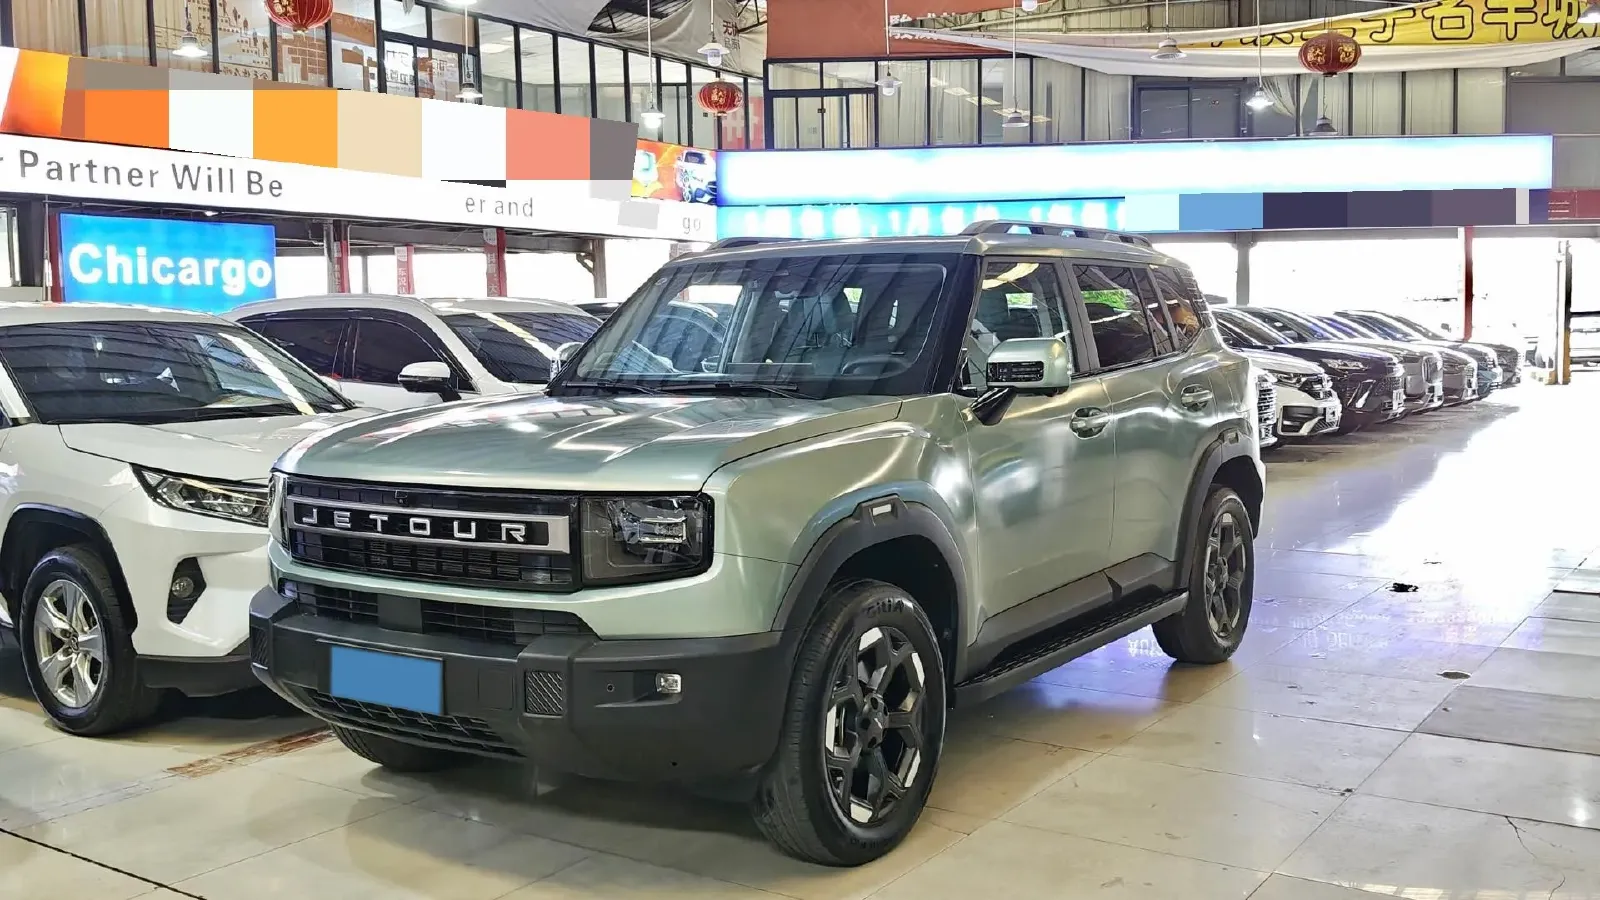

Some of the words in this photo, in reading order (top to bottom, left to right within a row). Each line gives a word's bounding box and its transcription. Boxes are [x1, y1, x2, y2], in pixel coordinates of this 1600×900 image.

[19, 149, 159, 187] Partner
[171, 163, 234, 194] Will
[247, 170, 284, 197] Be
[494, 197, 533, 217] and
[69, 243, 273, 296] Chicargo
[302, 508, 526, 542] JETOUR
